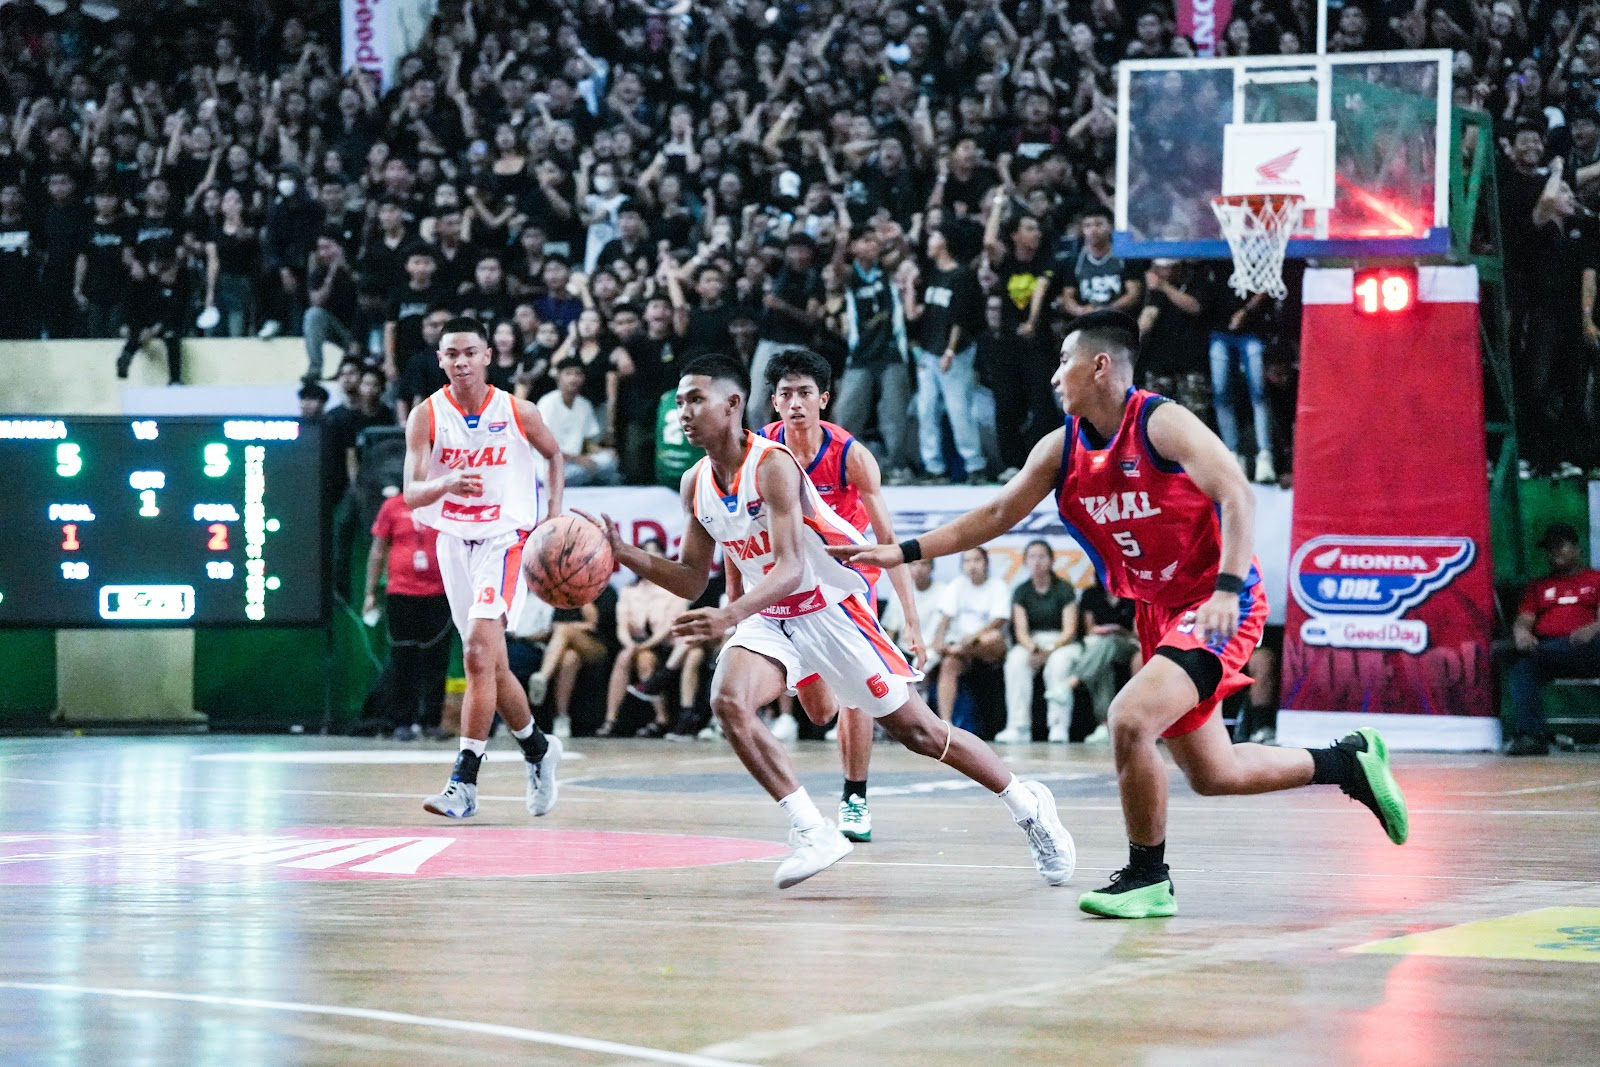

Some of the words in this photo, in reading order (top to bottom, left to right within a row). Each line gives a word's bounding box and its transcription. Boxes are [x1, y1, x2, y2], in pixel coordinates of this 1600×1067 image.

[356, 0, 382, 63] ood
[56, 443, 82, 477] 5
[204, 443, 231, 477] 5
[139, 490, 160, 516] 1
[62, 524, 80, 551] 1
[208, 523, 230, 551] 2
[1112, 531, 1142, 557] 5
[1340, 554, 1428, 570] HONDA
[866, 672, 890, 699] 6
